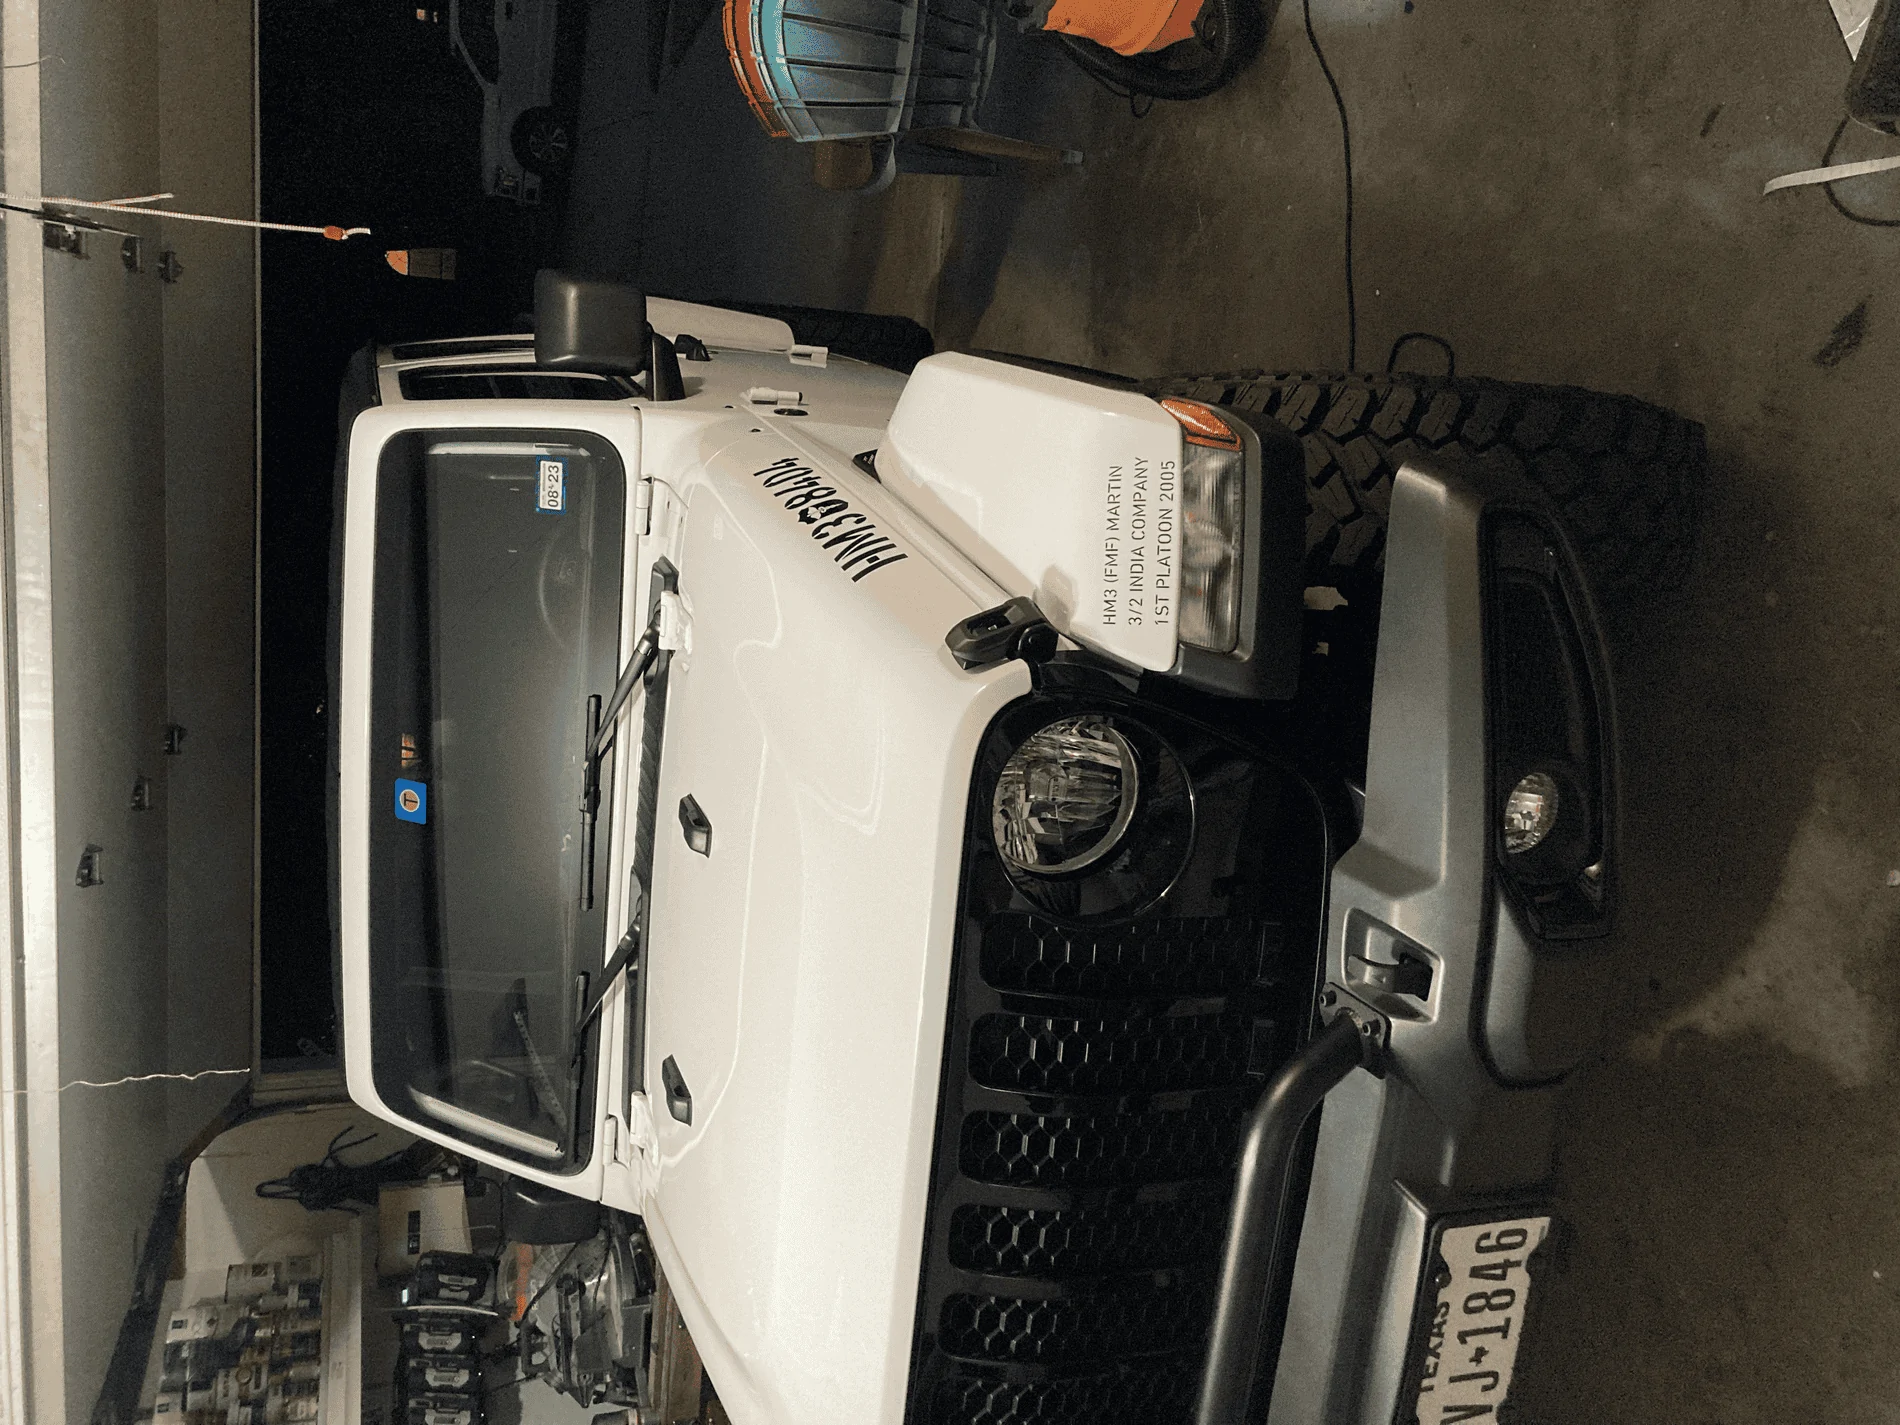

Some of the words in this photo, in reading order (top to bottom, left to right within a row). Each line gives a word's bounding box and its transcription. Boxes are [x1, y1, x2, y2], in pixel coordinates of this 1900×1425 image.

[547, 465, 559, 483] 23
[1158, 460, 1176, 502] 2005
[547, 490, 559, 508] 08
[1105, 465, 1123, 531] MARTIN
[1130, 456, 1149, 541] COMPANY
[1103, 536, 1121, 583] (FMF)
[1129, 545, 1146, 592] INDIA
[1155, 508, 1173, 589] PLATOON
[1102, 588, 1118, 626] HM3
[1127, 597, 1143, 627] 3/2
[1154, 593, 1170, 626] 1ST
